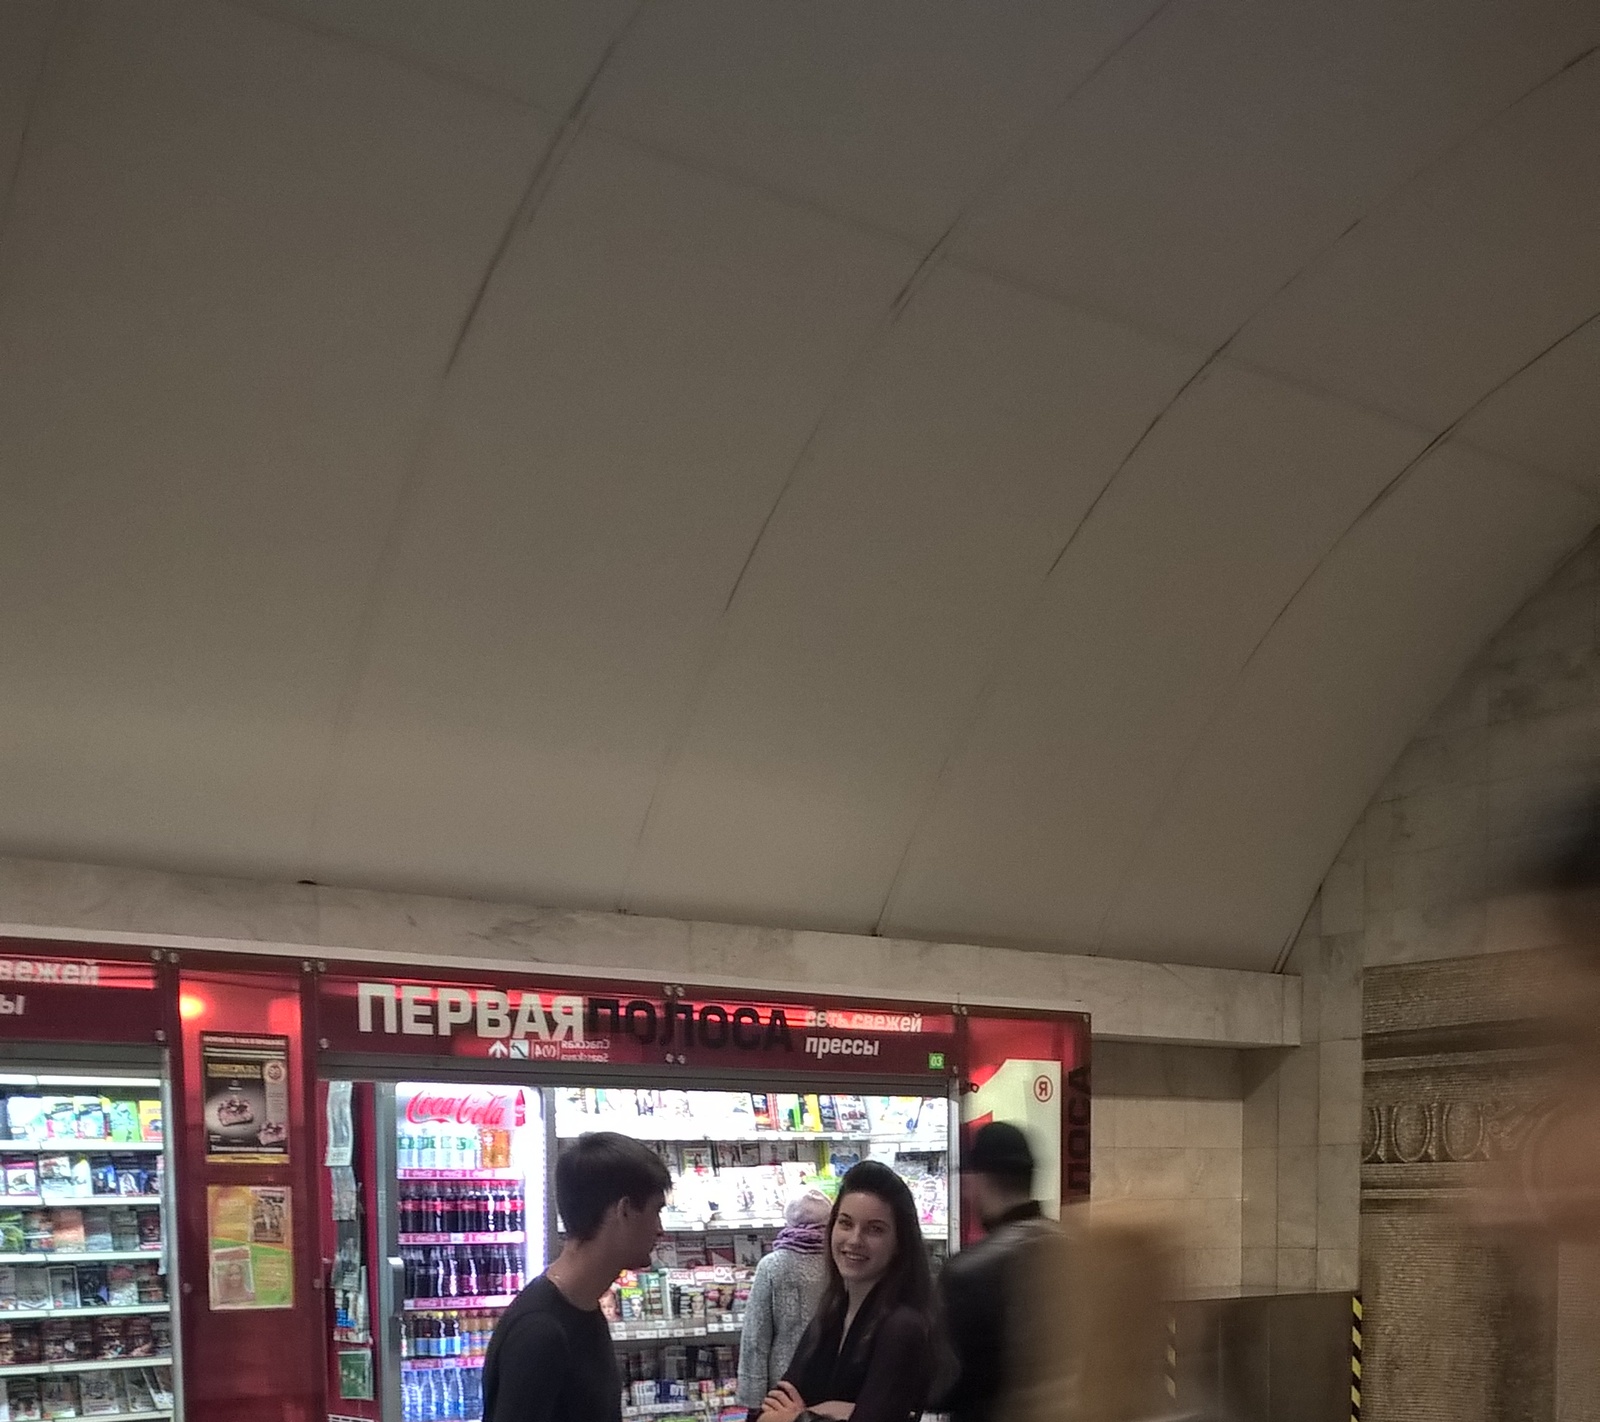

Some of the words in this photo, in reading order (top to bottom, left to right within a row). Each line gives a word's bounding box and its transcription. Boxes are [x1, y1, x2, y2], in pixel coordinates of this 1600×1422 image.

[0, 959, 99, 986] вежей
[357, 982, 585, 1041] ПЕРВАЯ
[588, 998, 793, 1052] ПОЛОСА
[806, 1010, 848, 1029] сеть
[852, 1013, 922, 1033] свежей
[805, 1037, 879, 1059] прессы
[406, 1090, 505, 1125] Coca-Cola
[1067, 1066, 1091, 1195] ЛОСА
